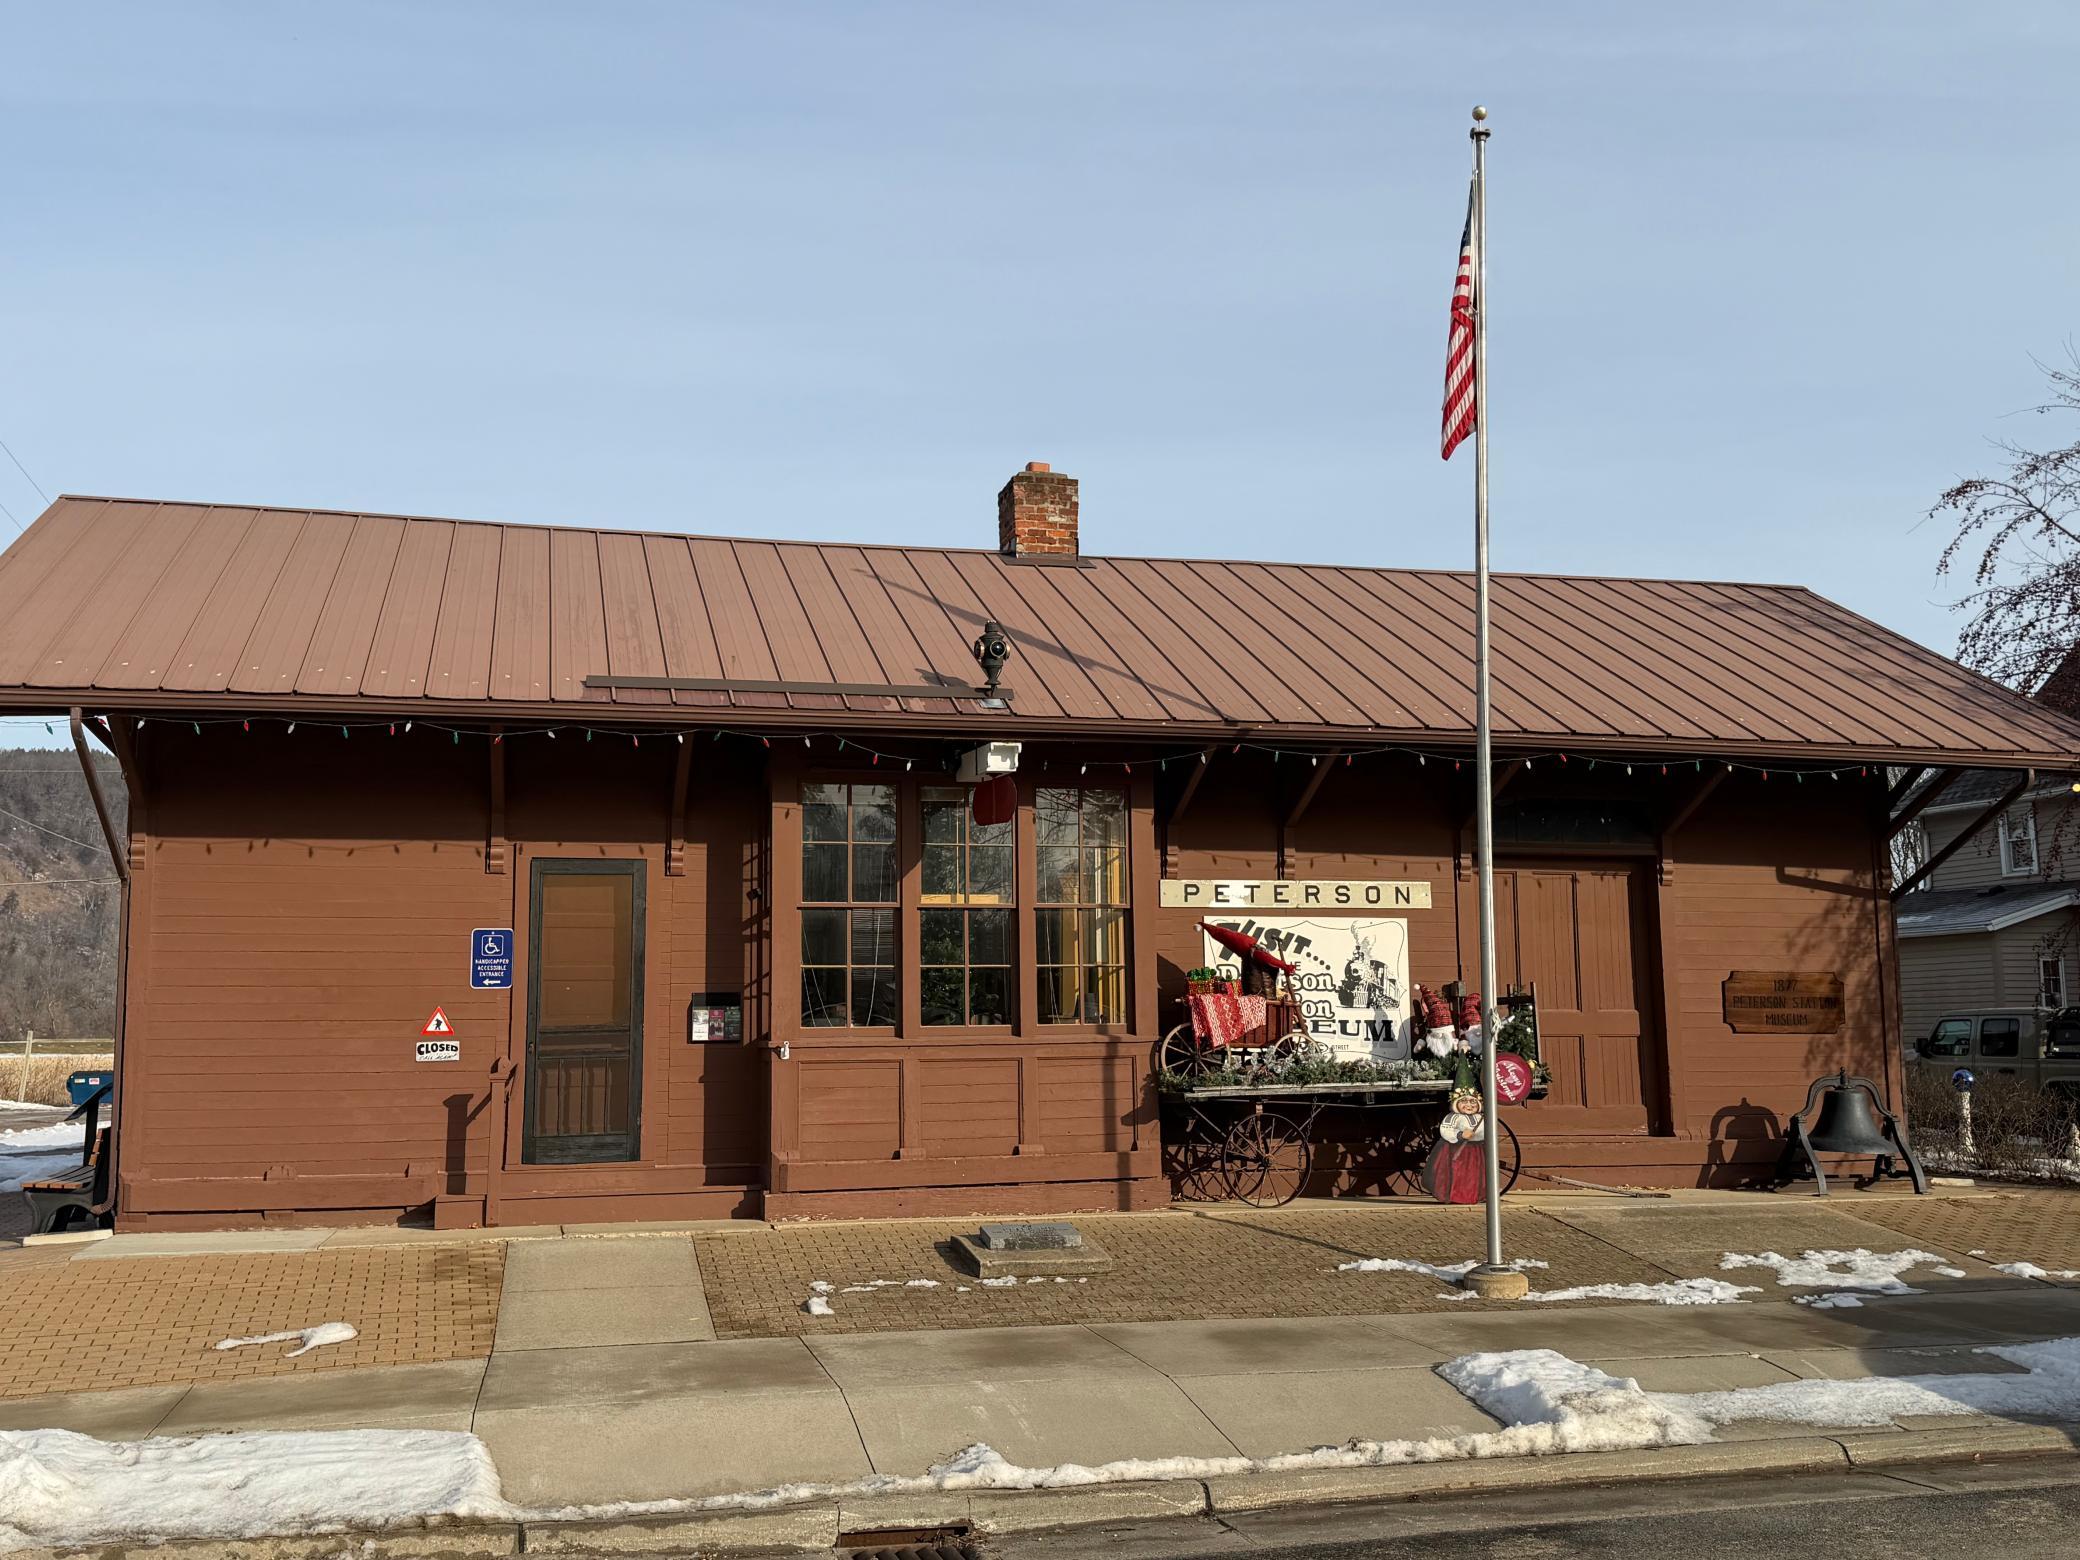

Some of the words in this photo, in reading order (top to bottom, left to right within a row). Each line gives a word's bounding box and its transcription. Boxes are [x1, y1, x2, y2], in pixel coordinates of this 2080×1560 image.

[1183, 883, 1411, 905] PETERSON
[1732, 995, 1786, 1009] PETERSON
[1792, 996, 1838, 1009] STATION
[1765, 1013, 1808, 1026] MUSEUM
[417, 1042, 459, 1056] CLOSED
